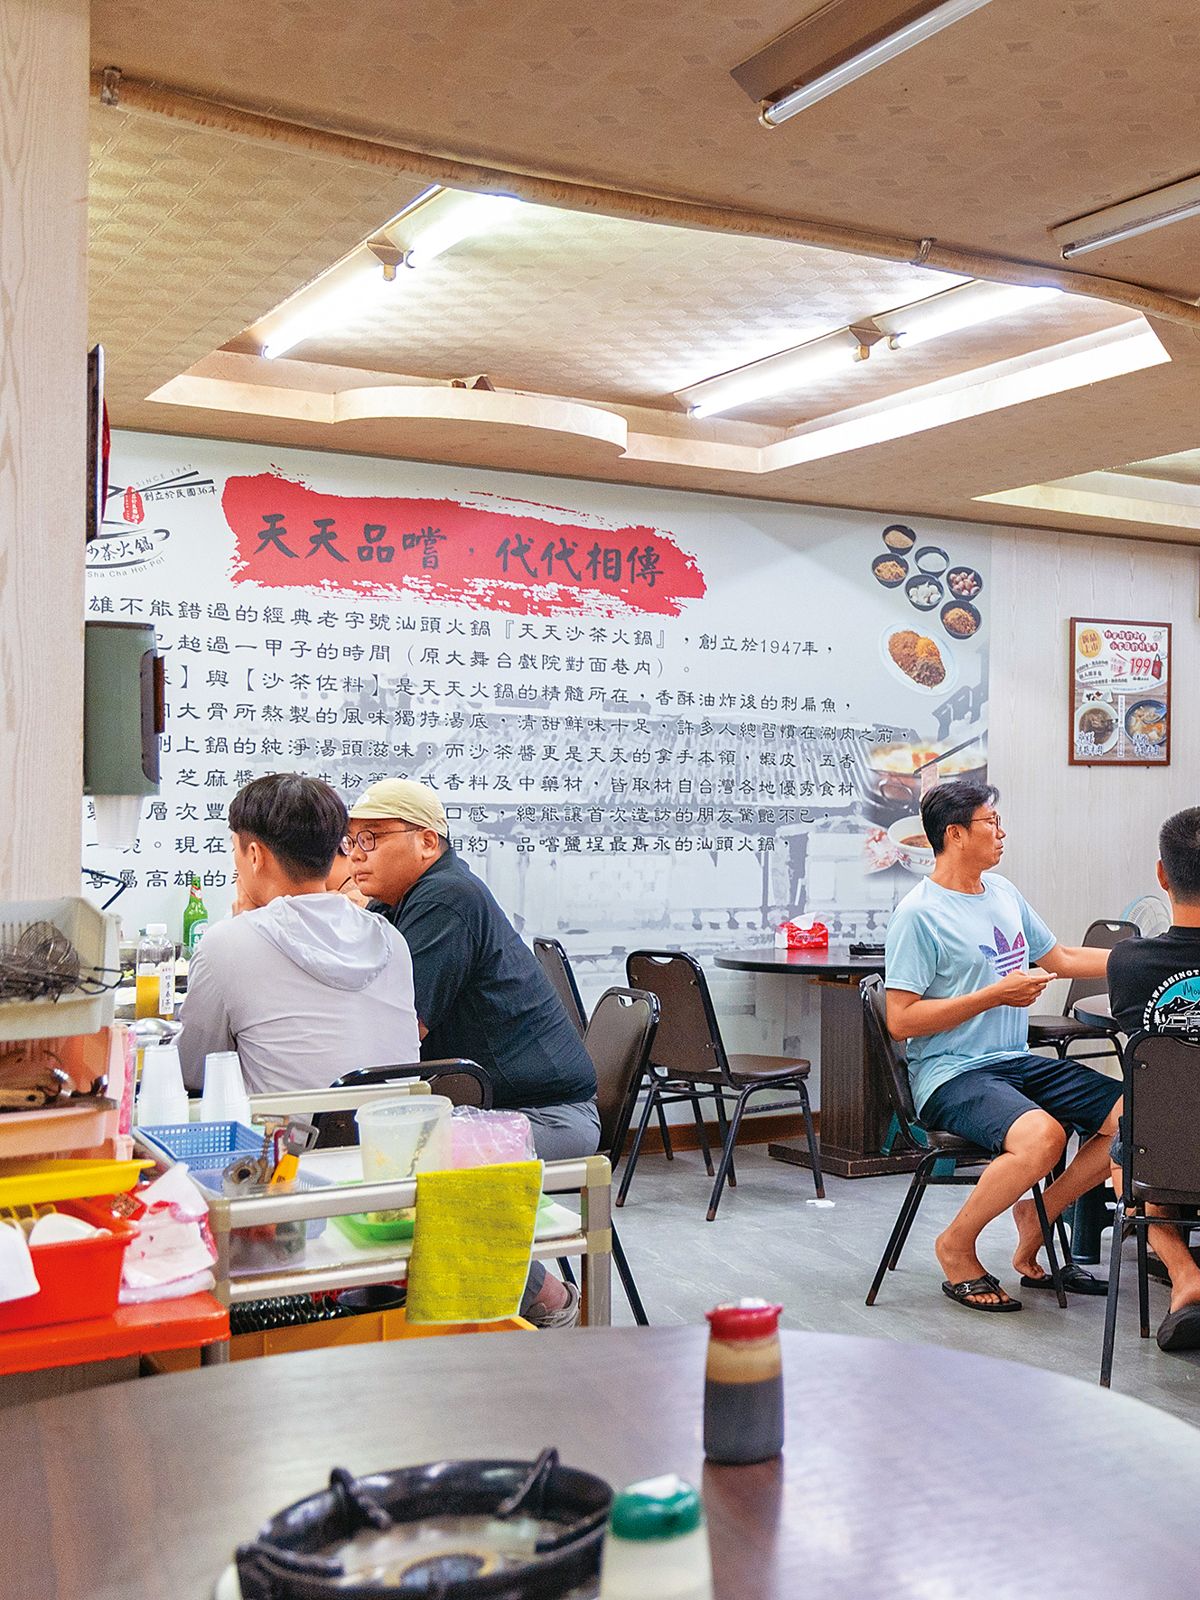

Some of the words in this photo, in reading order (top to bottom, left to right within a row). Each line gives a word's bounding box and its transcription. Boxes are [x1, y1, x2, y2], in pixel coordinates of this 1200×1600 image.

[109, 567, 127, 577] Cha
[132, 564, 147, 574] Hot
[150, 556, 165, 567] Pot
[1130, 658, 1151, 675] 199
